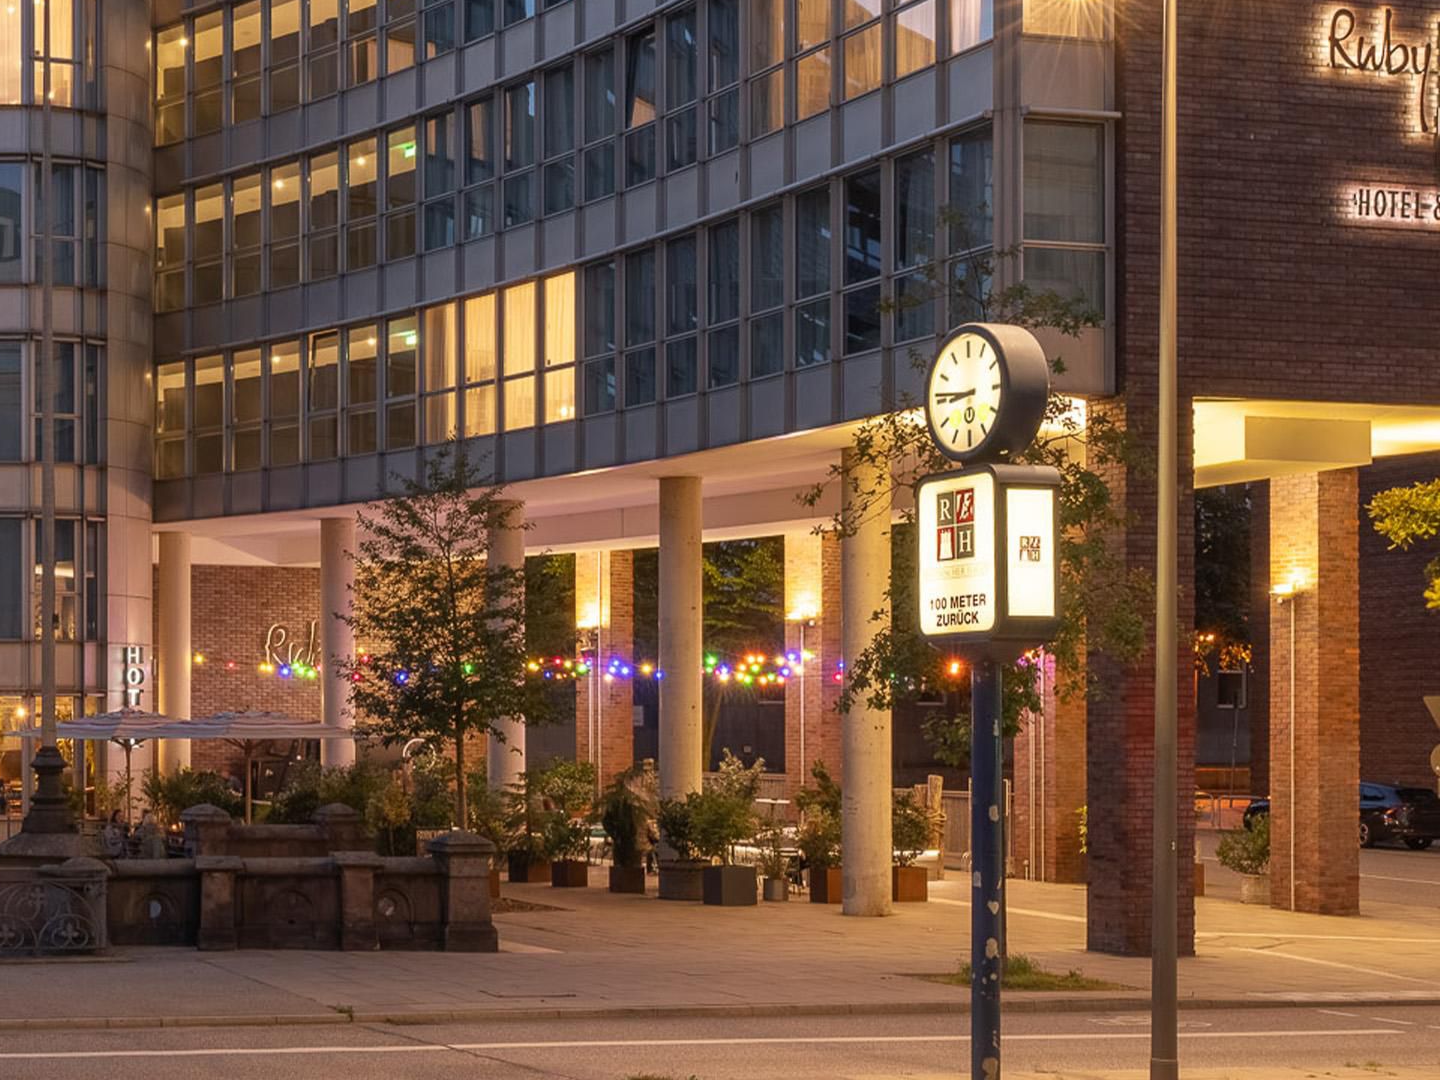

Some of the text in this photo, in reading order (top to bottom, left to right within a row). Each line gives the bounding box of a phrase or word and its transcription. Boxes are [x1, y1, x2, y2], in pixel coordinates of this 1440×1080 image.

[1329, 8, 1431, 133] Ruby
[1359, 189, 1424, 219] HOTEL
[930, 593, 986, 610] 100 METER
[936, 609, 979, 627] ZURÜCK
